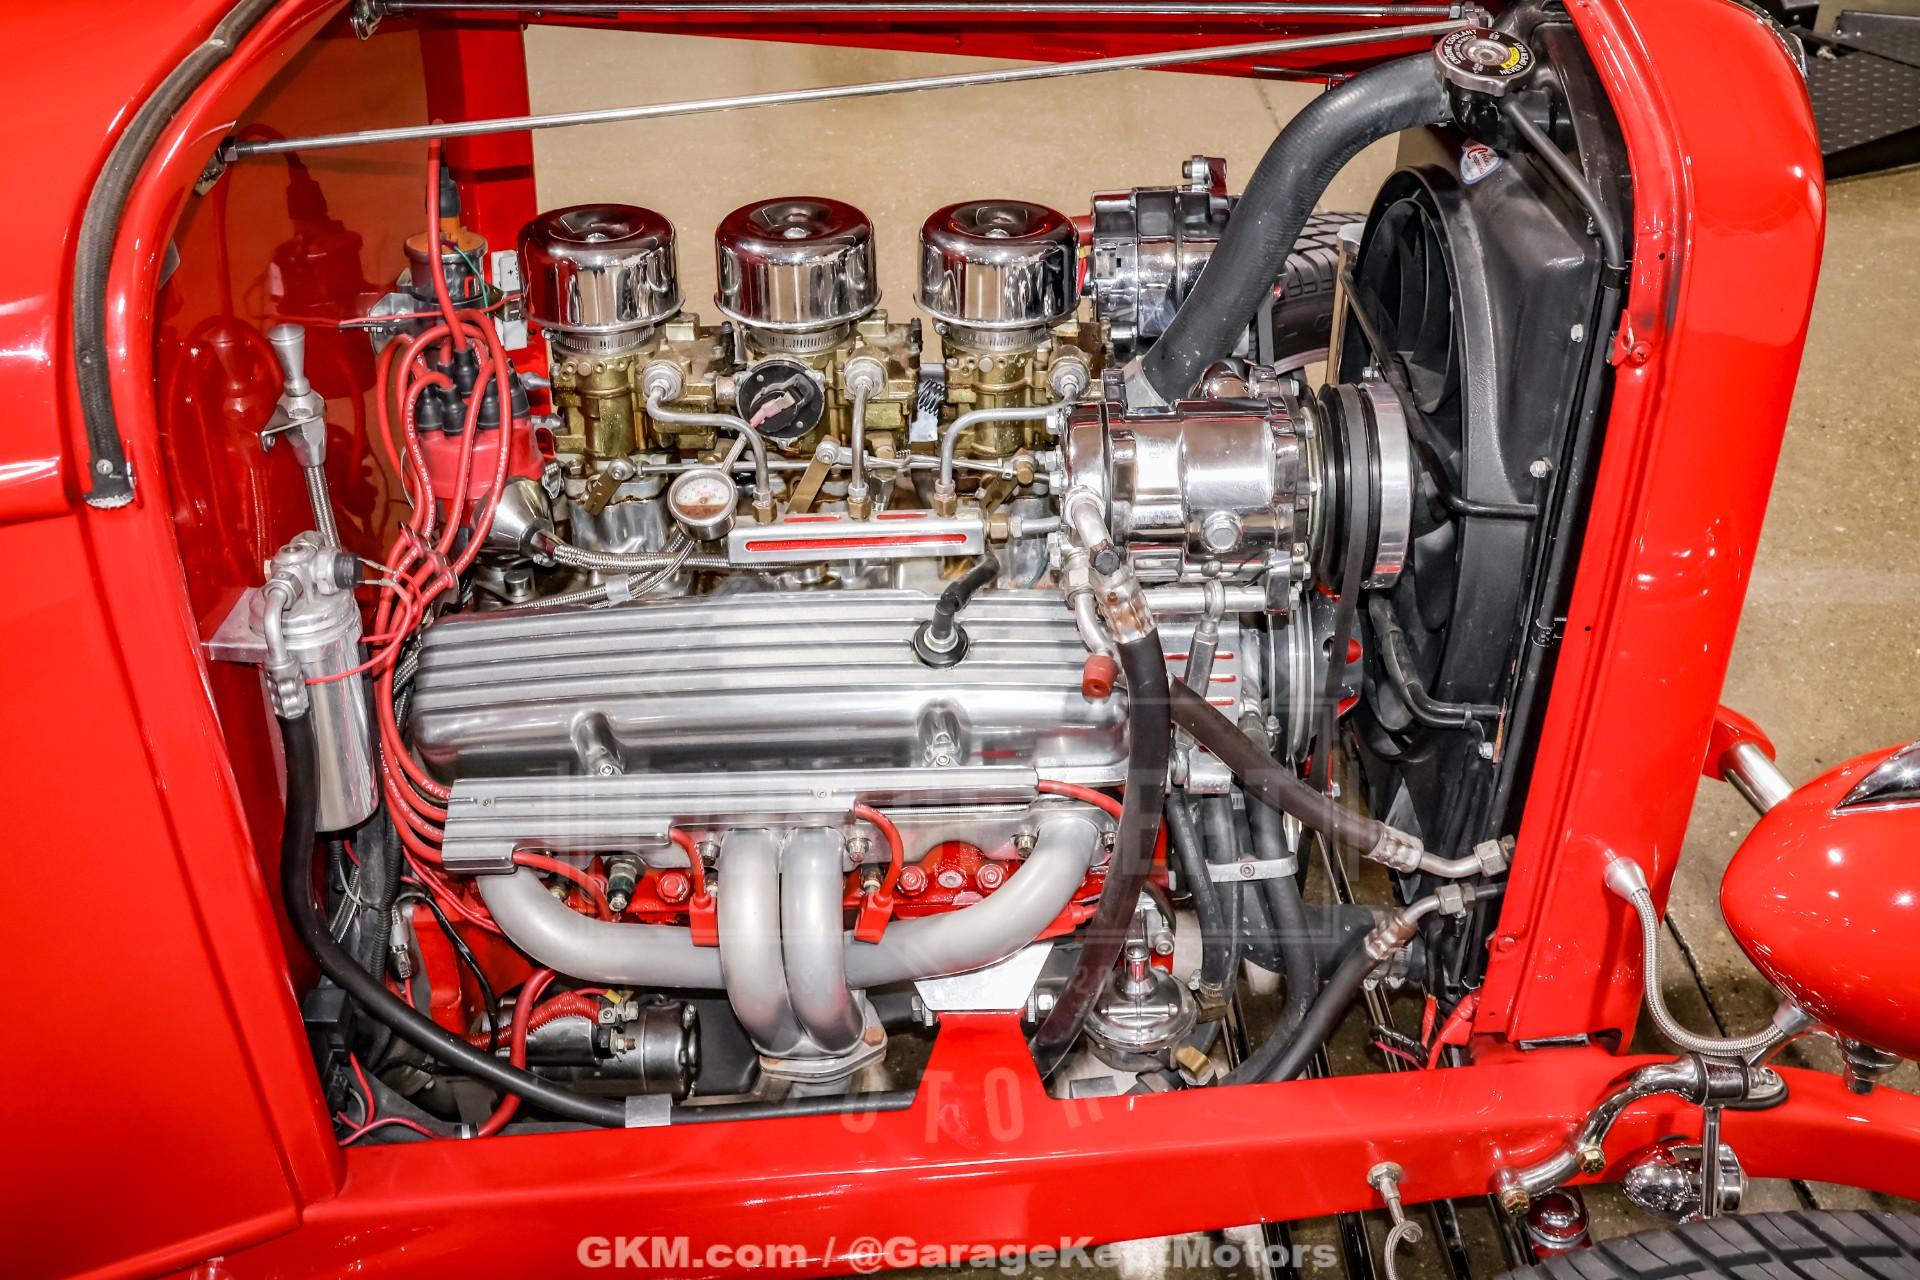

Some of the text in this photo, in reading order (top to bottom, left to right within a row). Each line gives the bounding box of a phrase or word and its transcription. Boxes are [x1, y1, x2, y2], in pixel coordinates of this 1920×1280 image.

[1443, 29, 1477, 65] ENGINE COOLANT
[1499, 64, 1524, 76] NEVER
[407, 398, 416, 440] TAYLOR
[412, 444, 423, 465] SPIRO
[420, 467, 430, 482] PRO
[494, 447, 508, 491] TAYLOR
[424, 504, 435, 538] SILICONE
[398, 799, 410, 812] PRO
